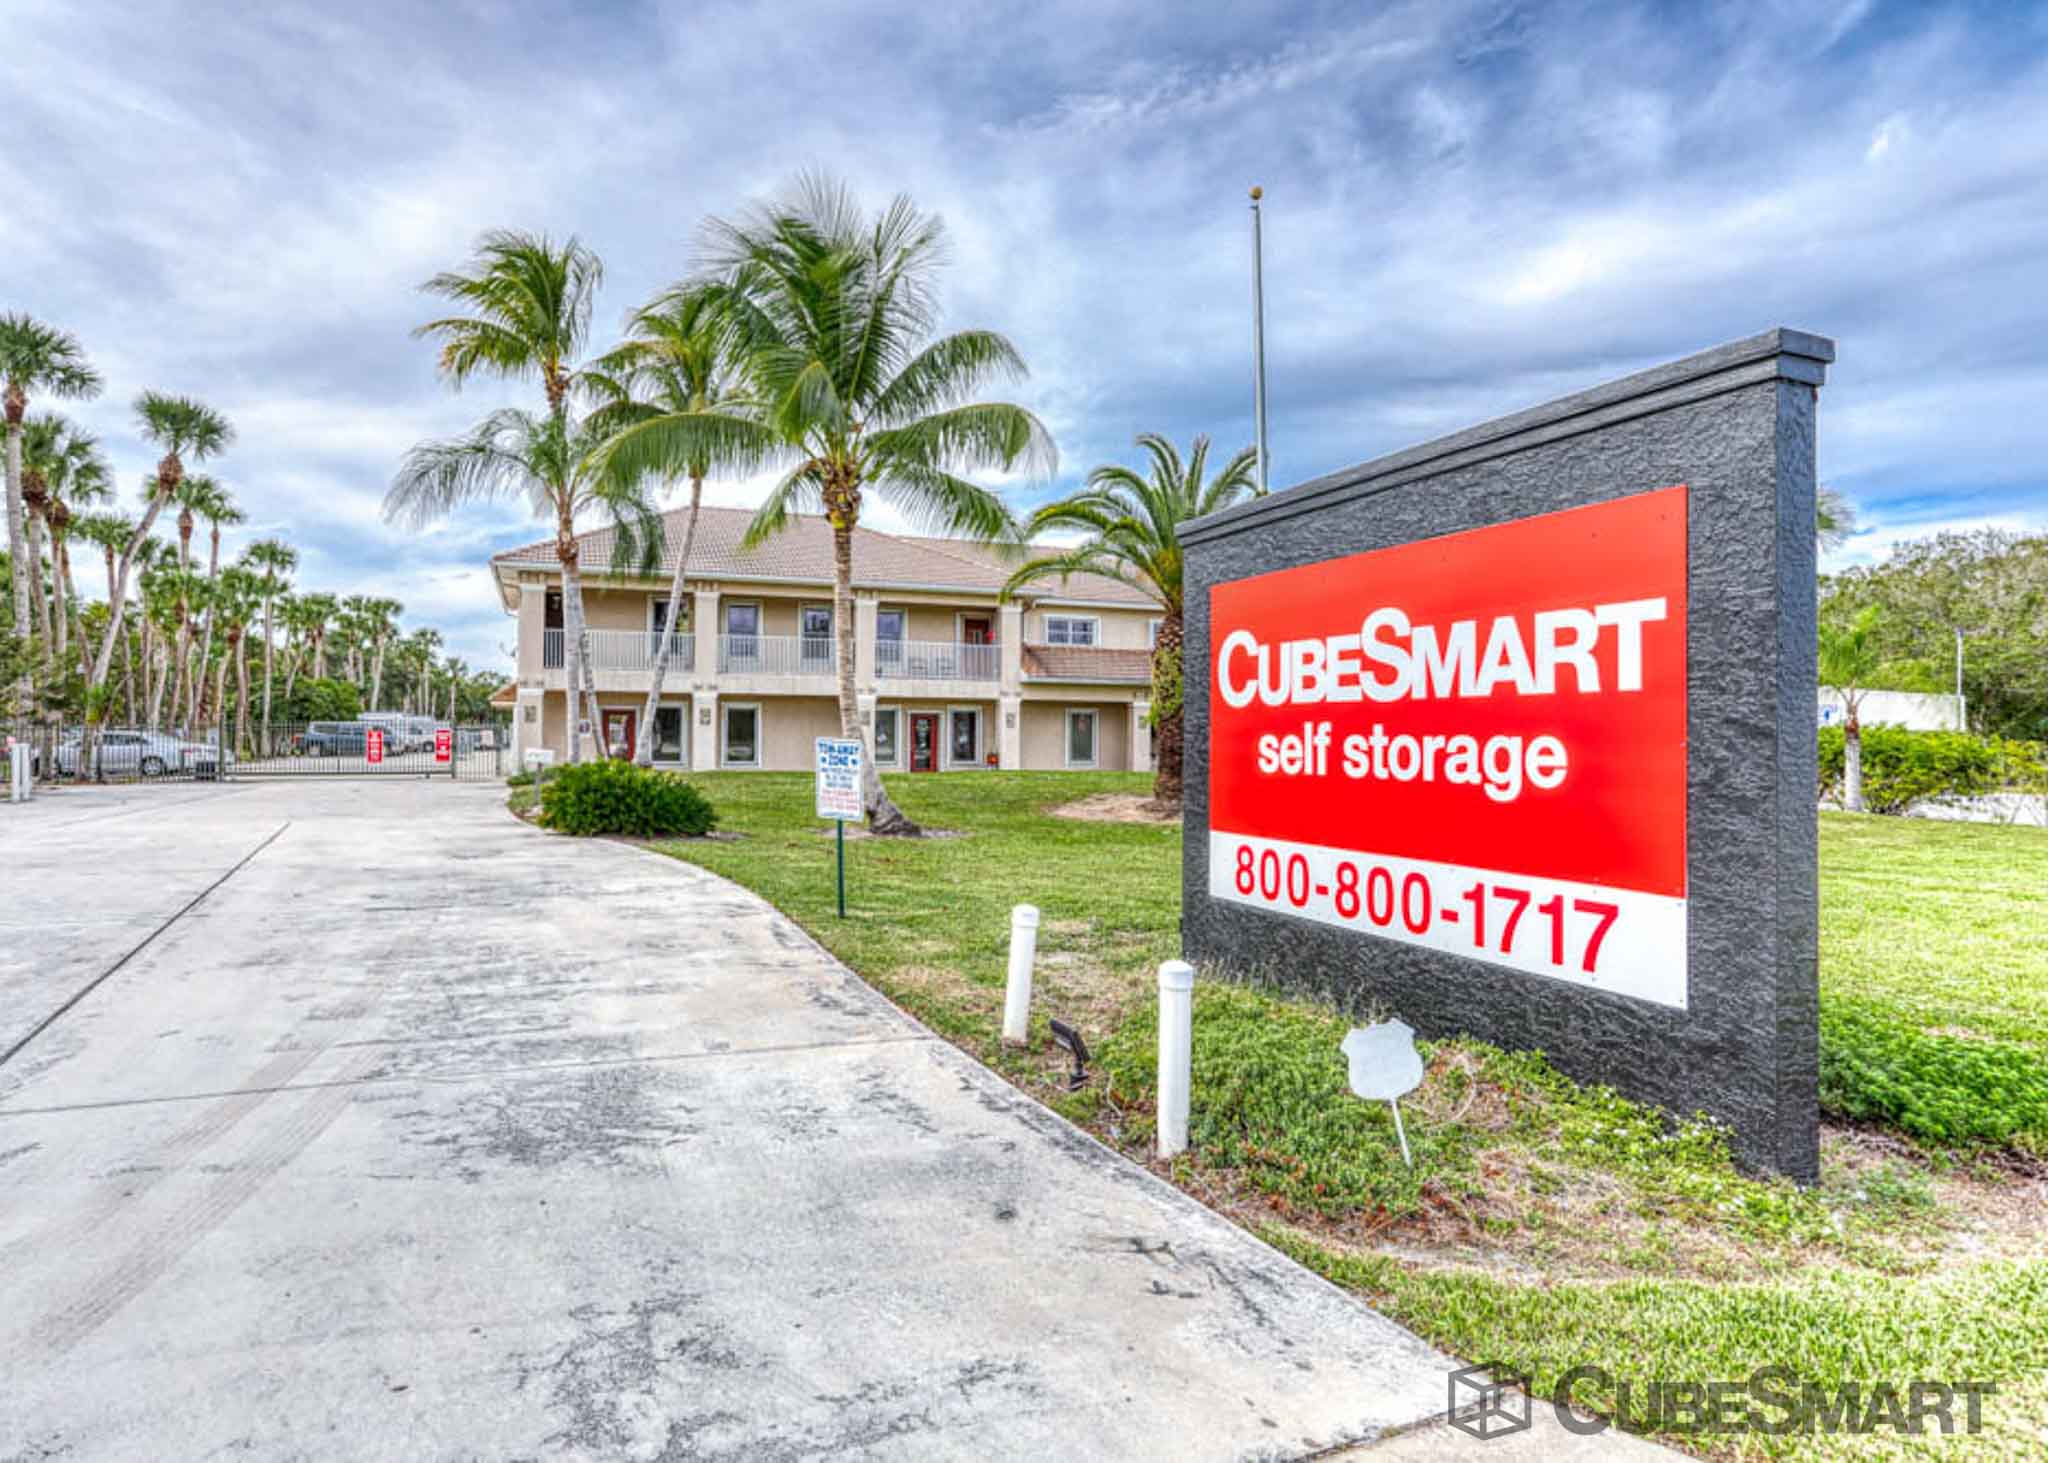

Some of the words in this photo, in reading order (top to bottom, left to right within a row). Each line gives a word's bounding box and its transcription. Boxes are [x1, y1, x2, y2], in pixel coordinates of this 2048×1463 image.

[1218, 598, 1667, 708] CUBESMART
[1257, 721, 1331, 776] self
[1343, 723, 1568, 801] storage
[1235, 845, 1619, 973] 800-800-1717
